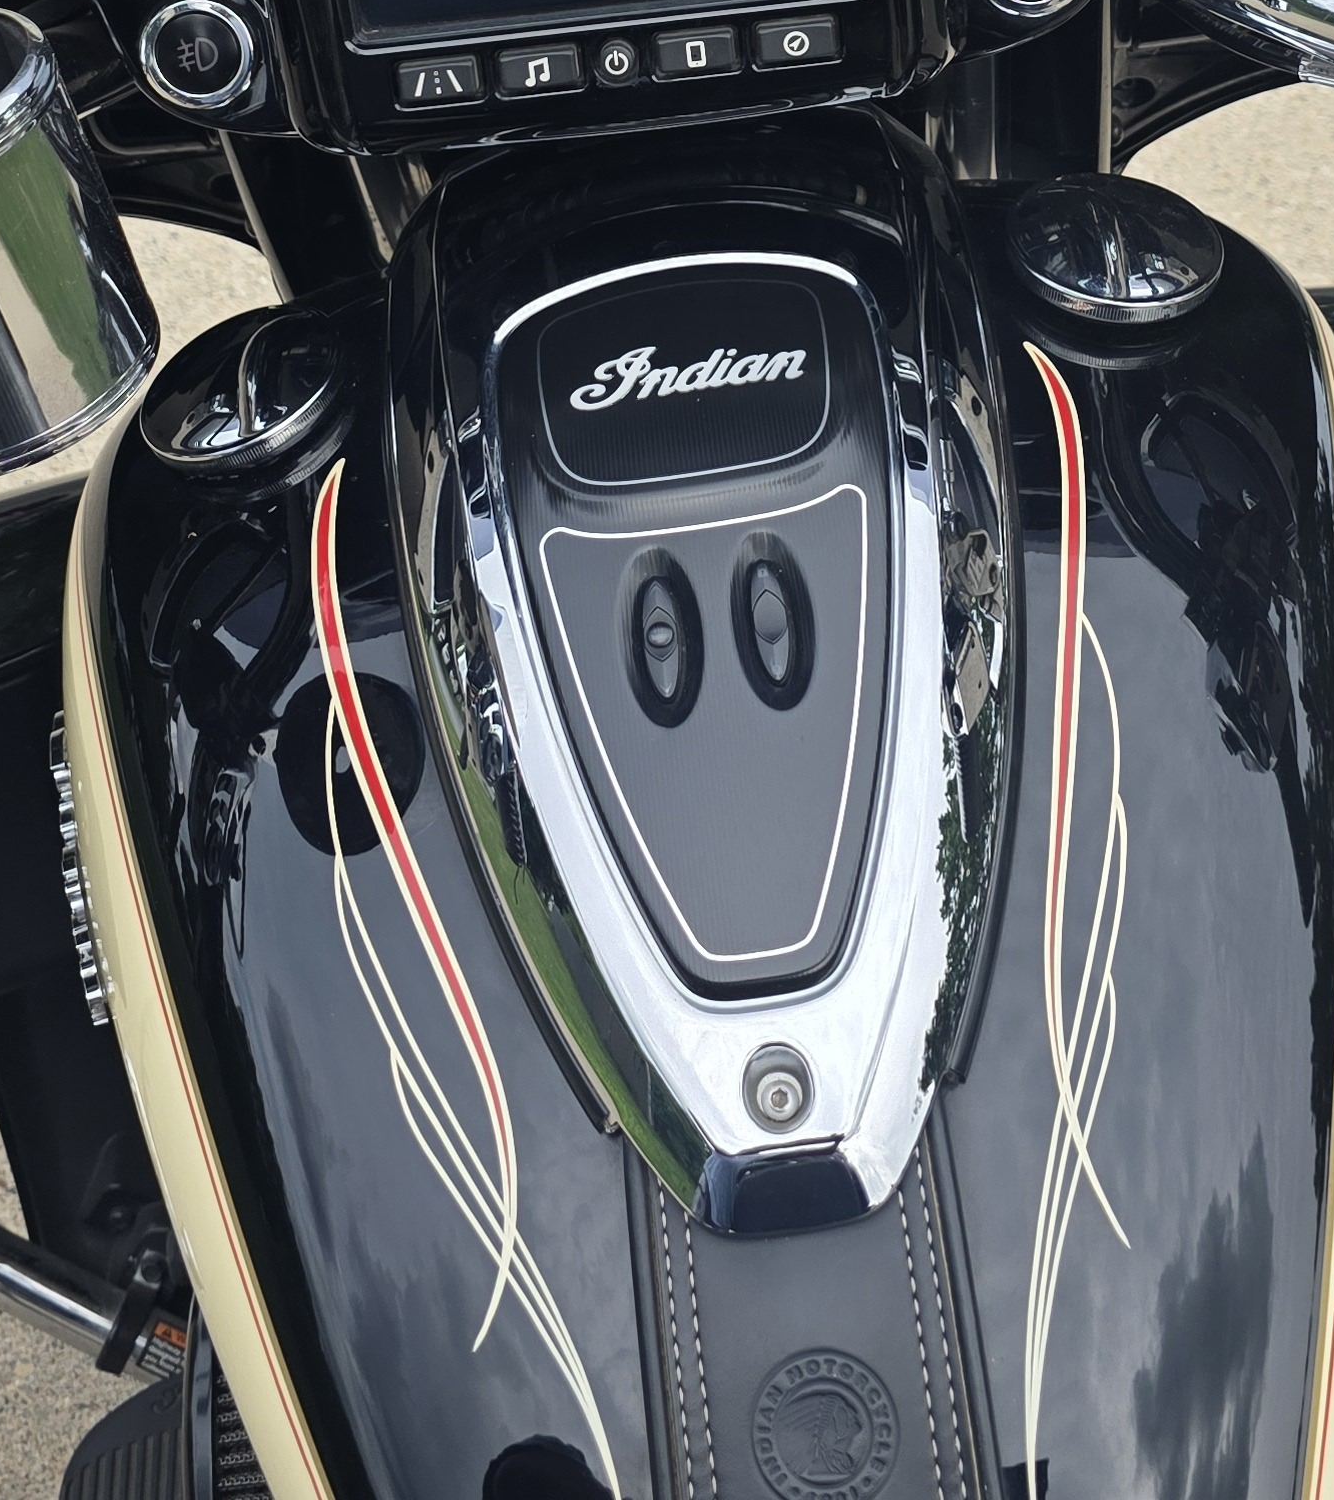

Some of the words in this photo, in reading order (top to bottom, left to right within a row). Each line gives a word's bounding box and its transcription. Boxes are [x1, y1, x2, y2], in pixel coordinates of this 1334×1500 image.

[569, 346, 807, 411] Indian
[755, 1384, 788, 1487] INDIAN
[784, 1357, 893, 1474] MOTORCYCLE
